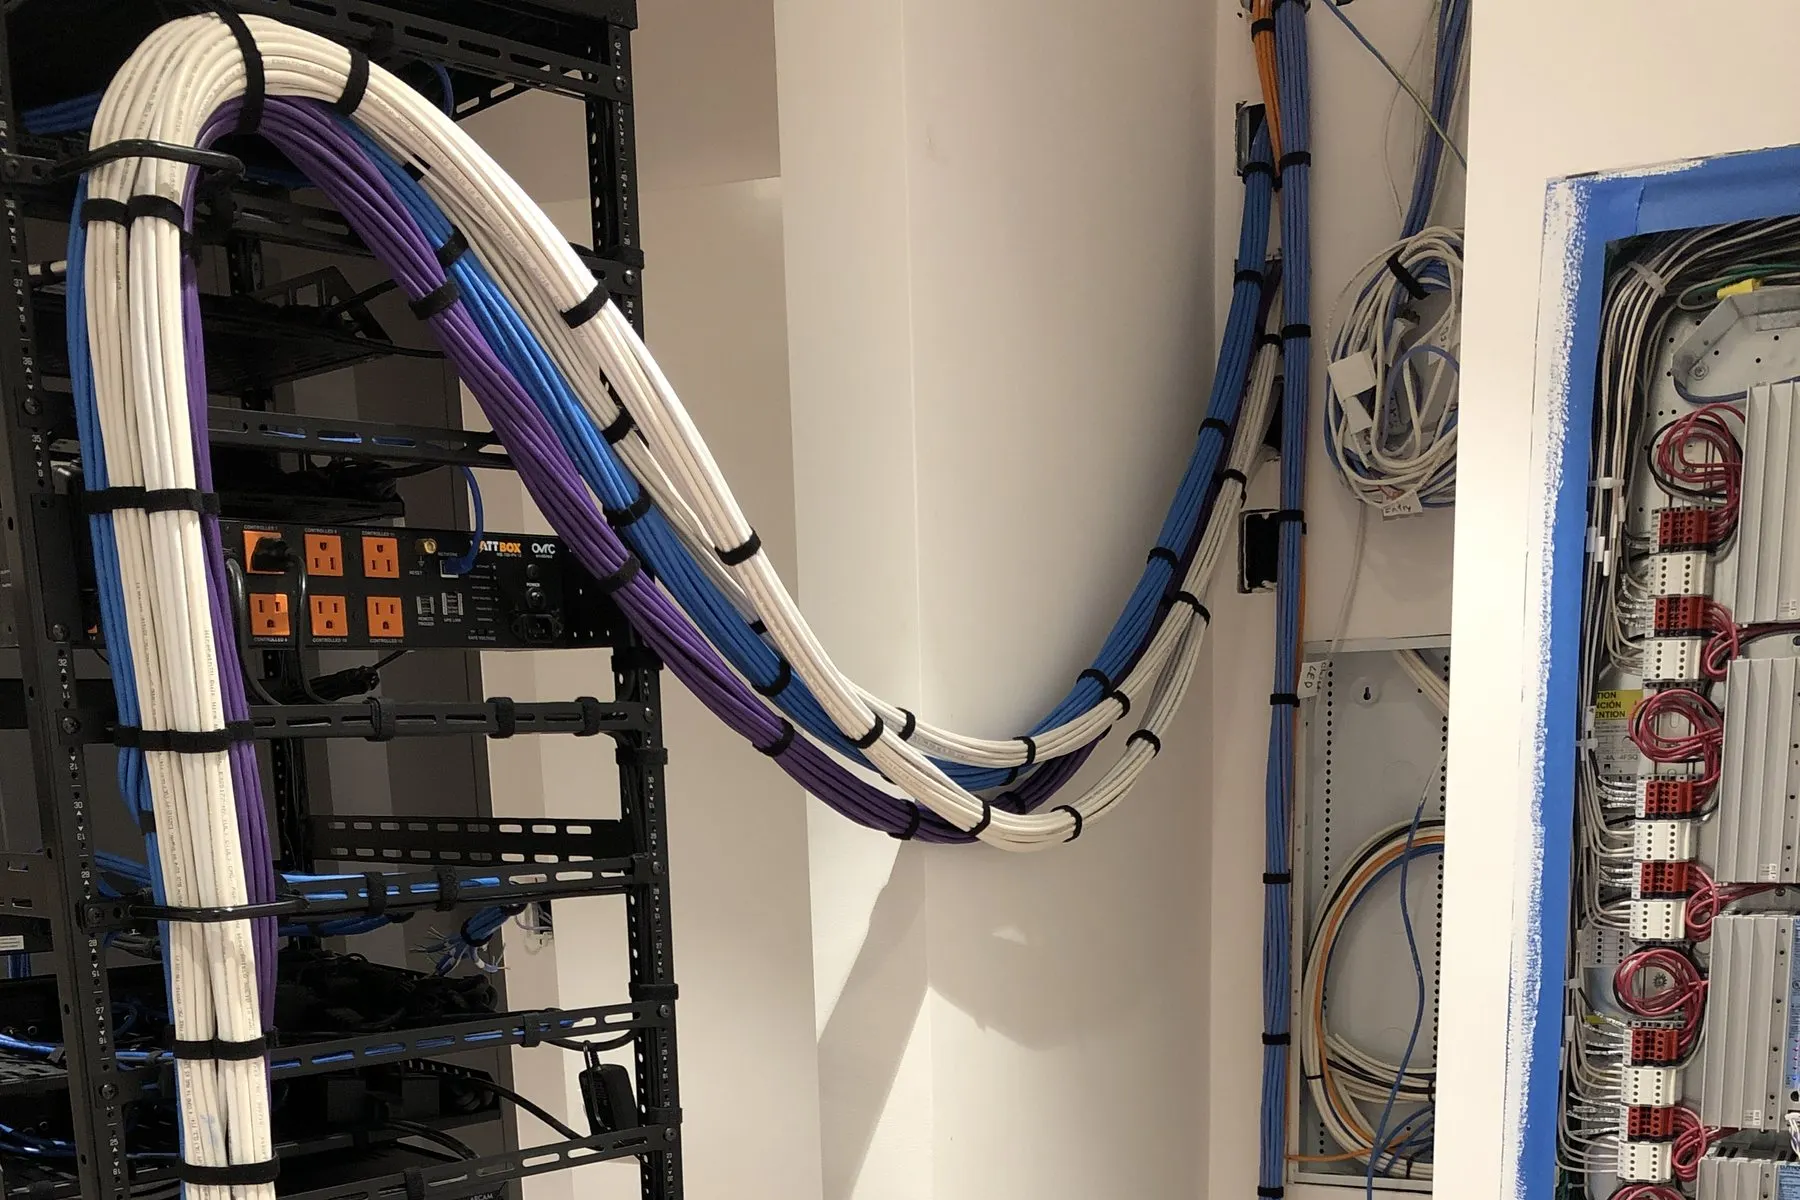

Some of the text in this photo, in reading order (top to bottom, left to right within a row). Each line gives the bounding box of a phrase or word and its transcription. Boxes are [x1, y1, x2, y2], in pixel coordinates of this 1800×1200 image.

[13, 278, 24, 287] 37
[31, 434, 42, 443] 35
[58, 658, 67, 666] 32
[1304, 665, 1317, 688] LED
[1597, 691, 1617, 699] TION
[1596, 700, 1622, 709] NCIÓN
[74, 801, 83, 809] 30
[95, 1006, 105, 1014] 27
